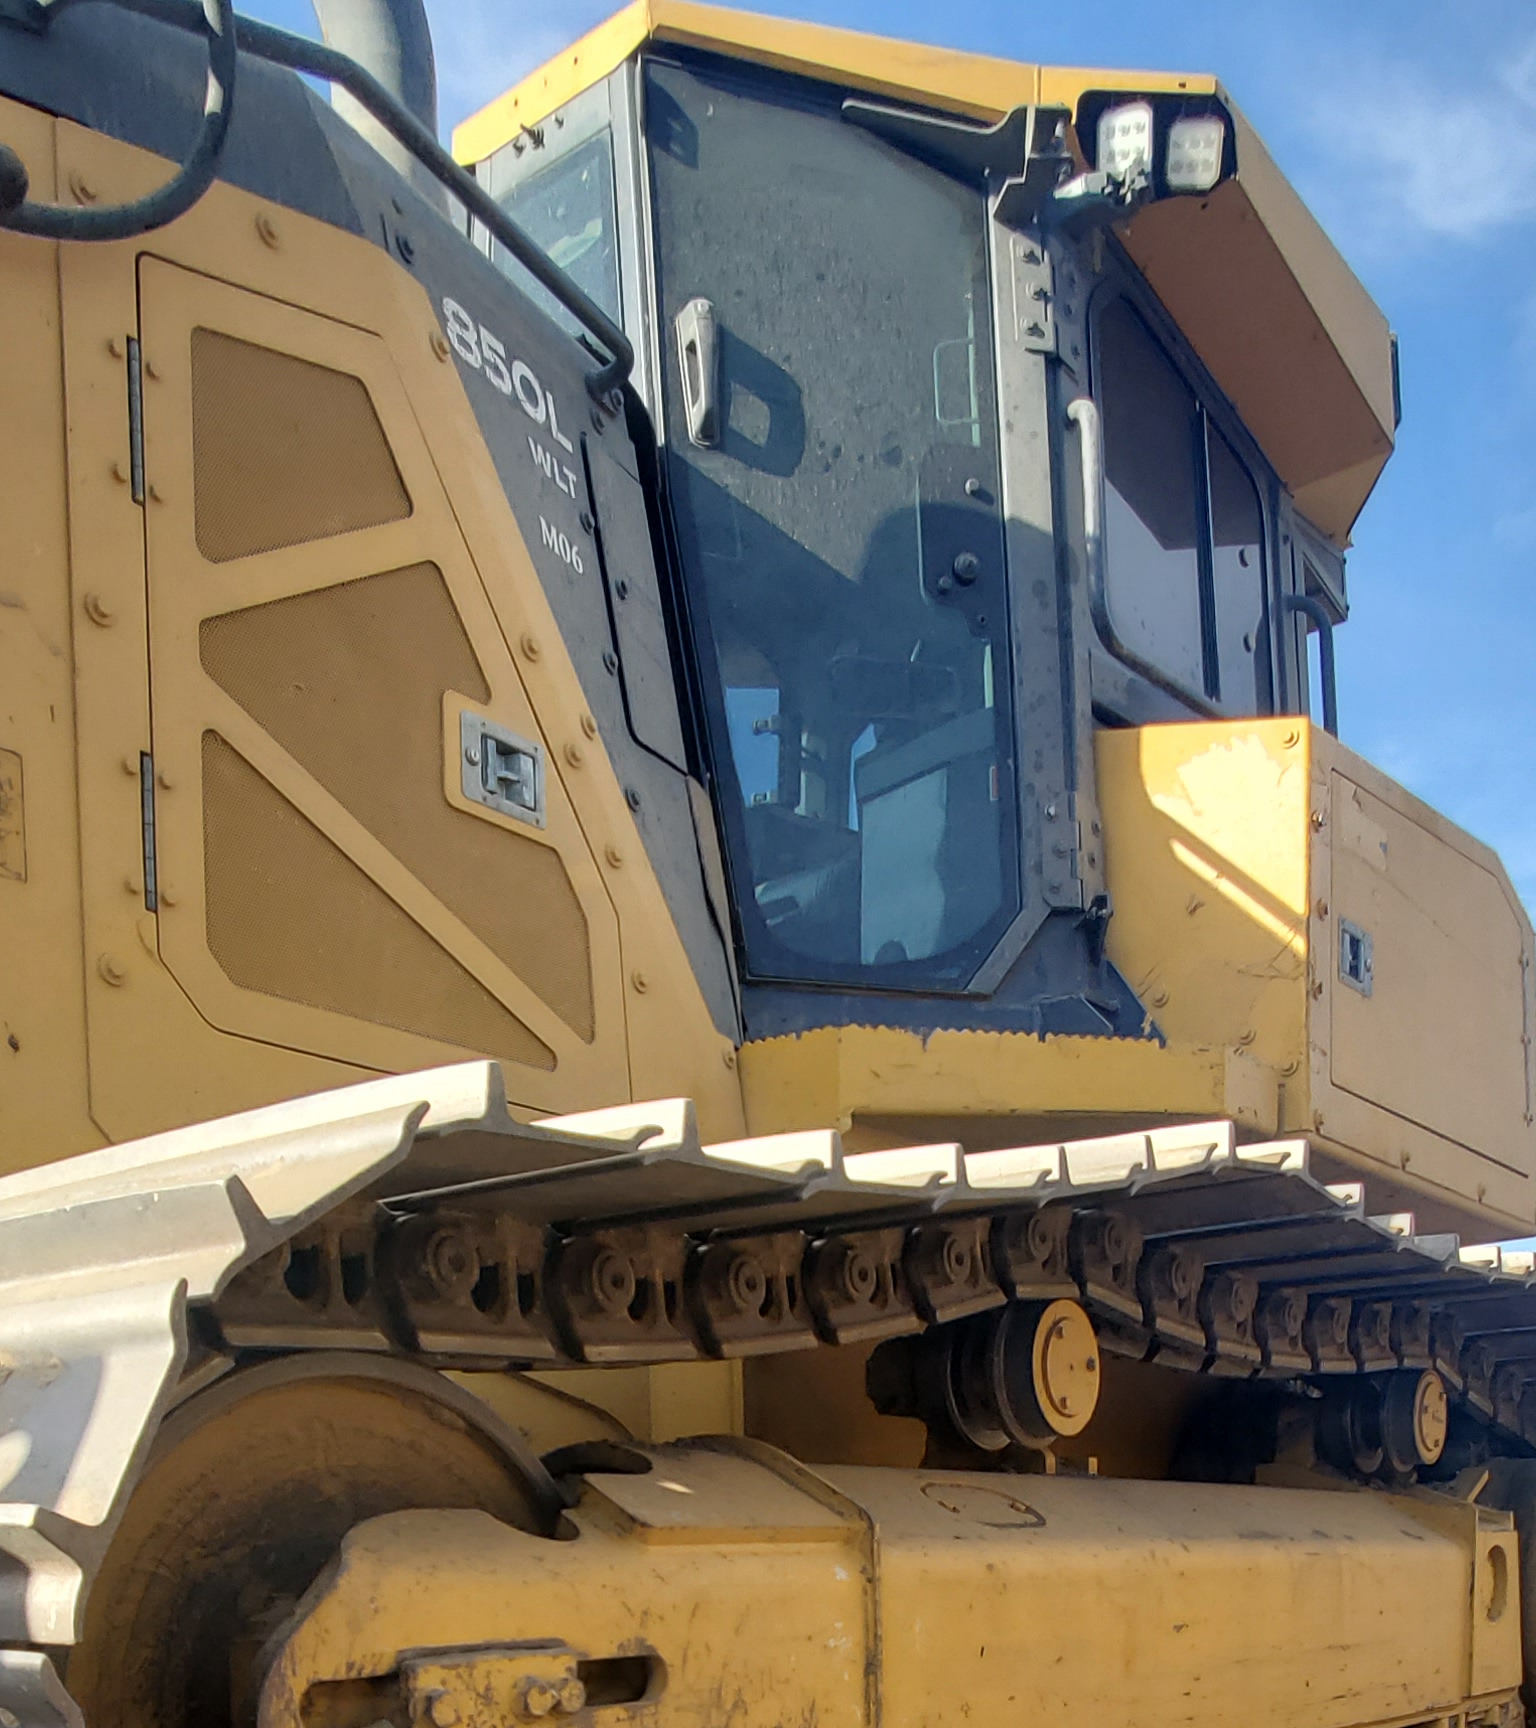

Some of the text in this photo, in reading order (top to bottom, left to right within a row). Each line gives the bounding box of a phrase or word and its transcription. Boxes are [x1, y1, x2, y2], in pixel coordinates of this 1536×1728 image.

[442, 297, 573, 453] 850L
[528, 436, 577, 499] WLT
[539, 515, 584, 574] M06
